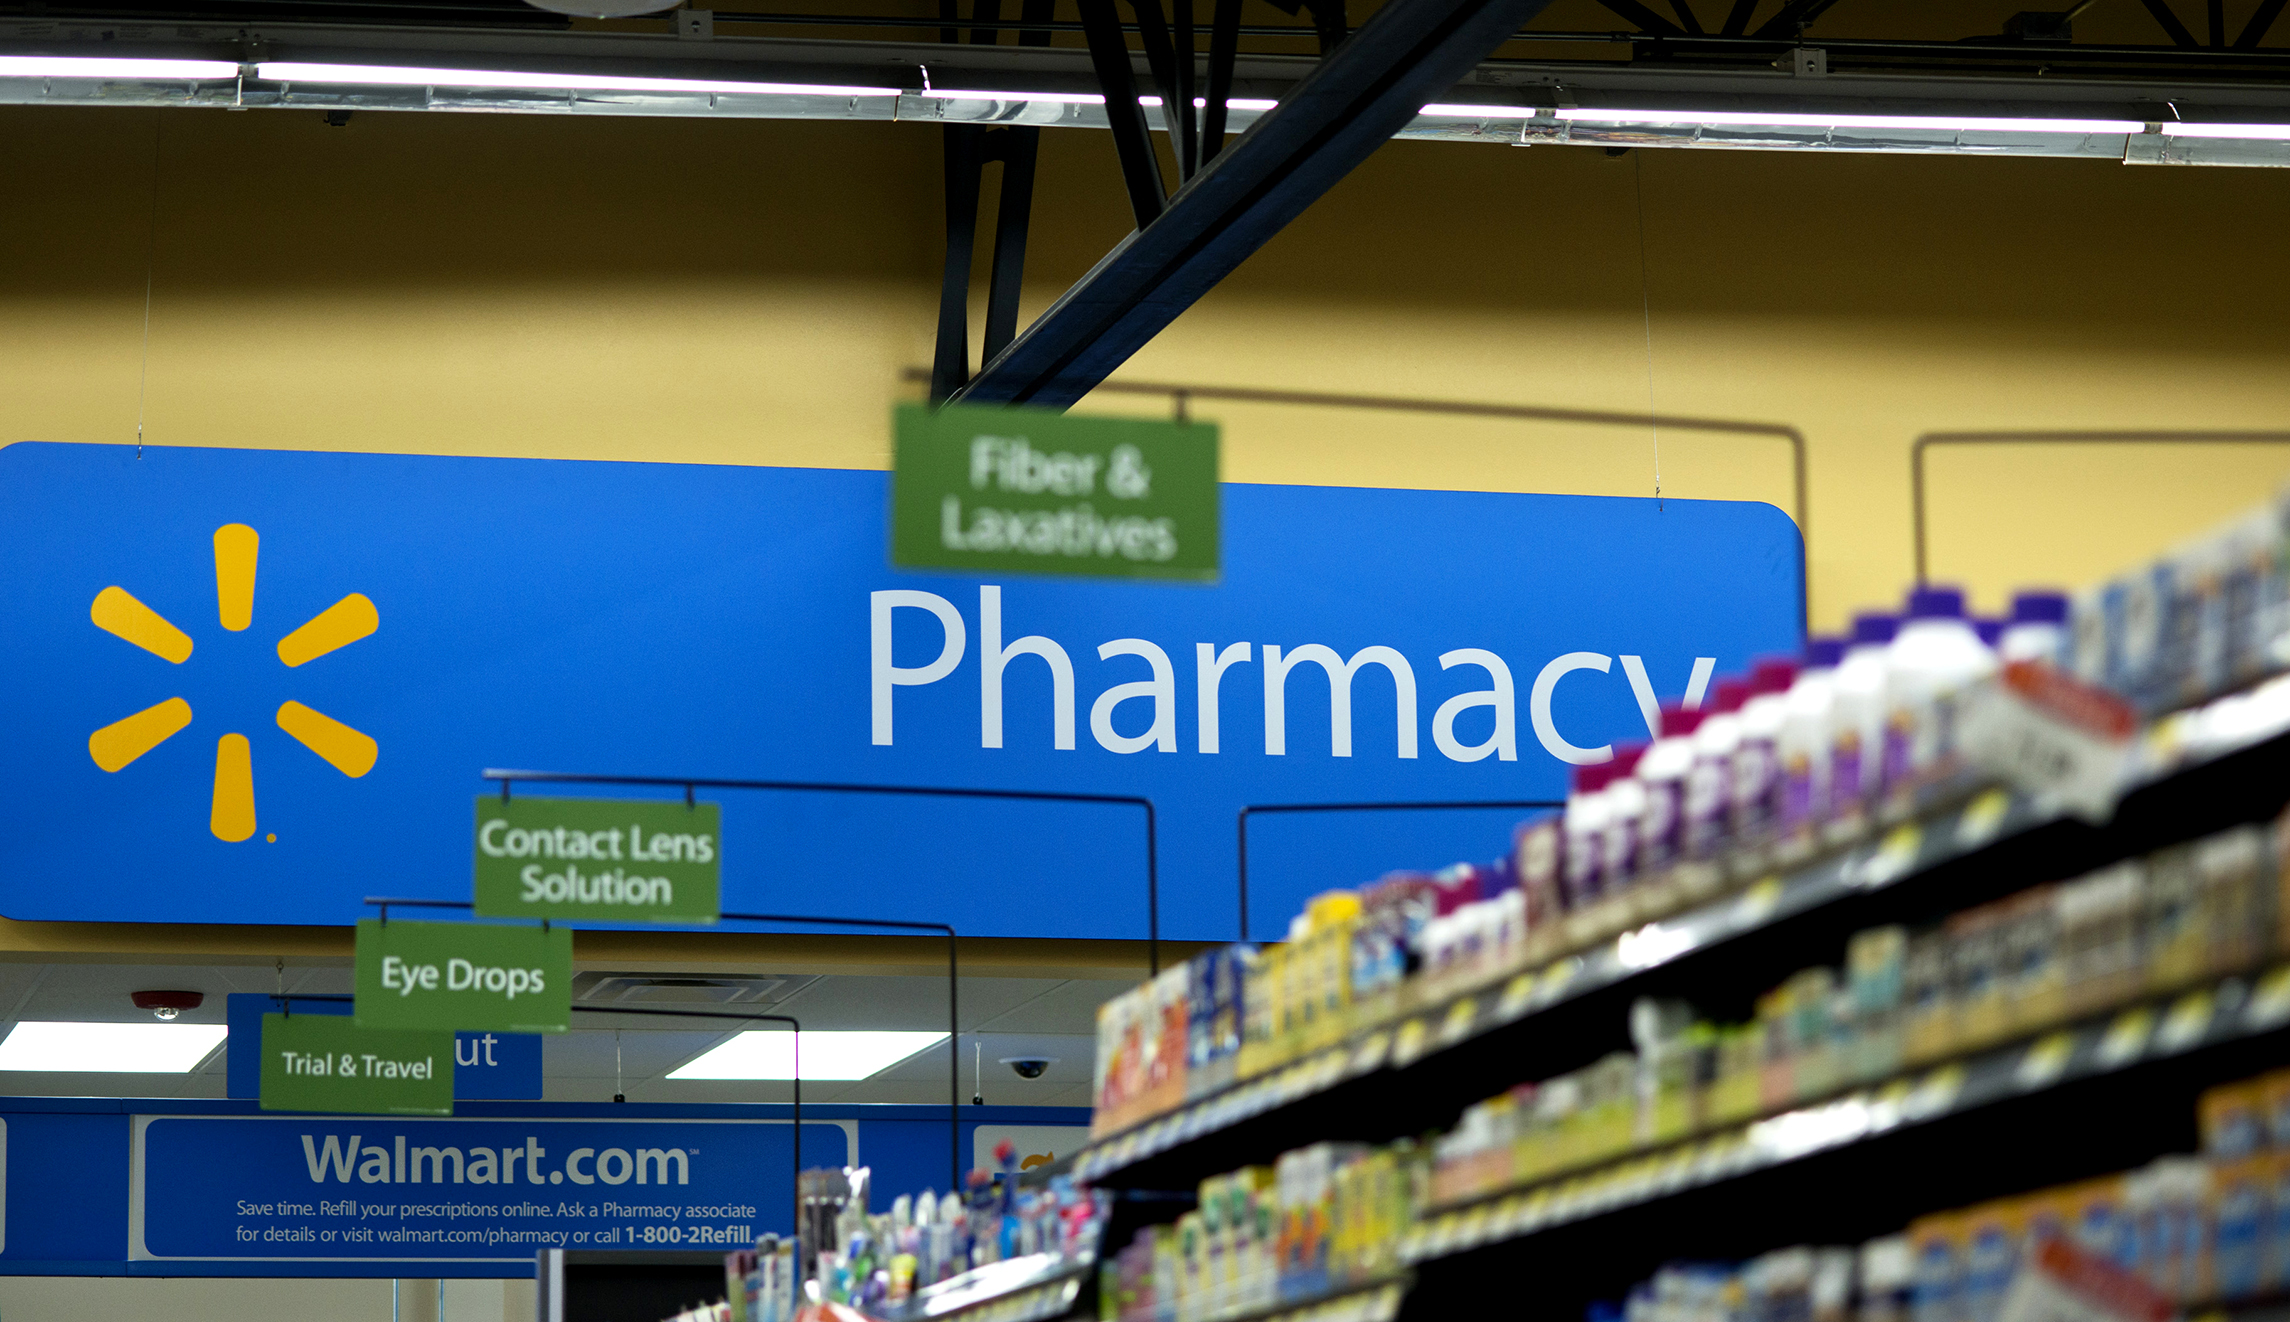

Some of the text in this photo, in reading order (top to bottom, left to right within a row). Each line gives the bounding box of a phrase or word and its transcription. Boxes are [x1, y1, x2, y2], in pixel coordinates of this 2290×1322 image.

[969, 435, 1151, 499] Fiber &
[941, 494, 1179, 561] Laxatives
[479, 818, 714, 863] Contact Lens
[520, 864, 672, 906] Solution
[381, 956, 546, 1000] Eye Drops
[282, 1052, 433, 1080] Trial & Travel
[455, 1033, 498, 1067] ut
[301, 1135, 689, 1185] Walmart.com
[236, 1200, 756, 1221] Save time. Refill your prescriptions online. Ask a Pharmacy associate
[236, 1225, 755, 1247] for details or visit walmart.com/pharmacy or call 1-800-2Refill.
